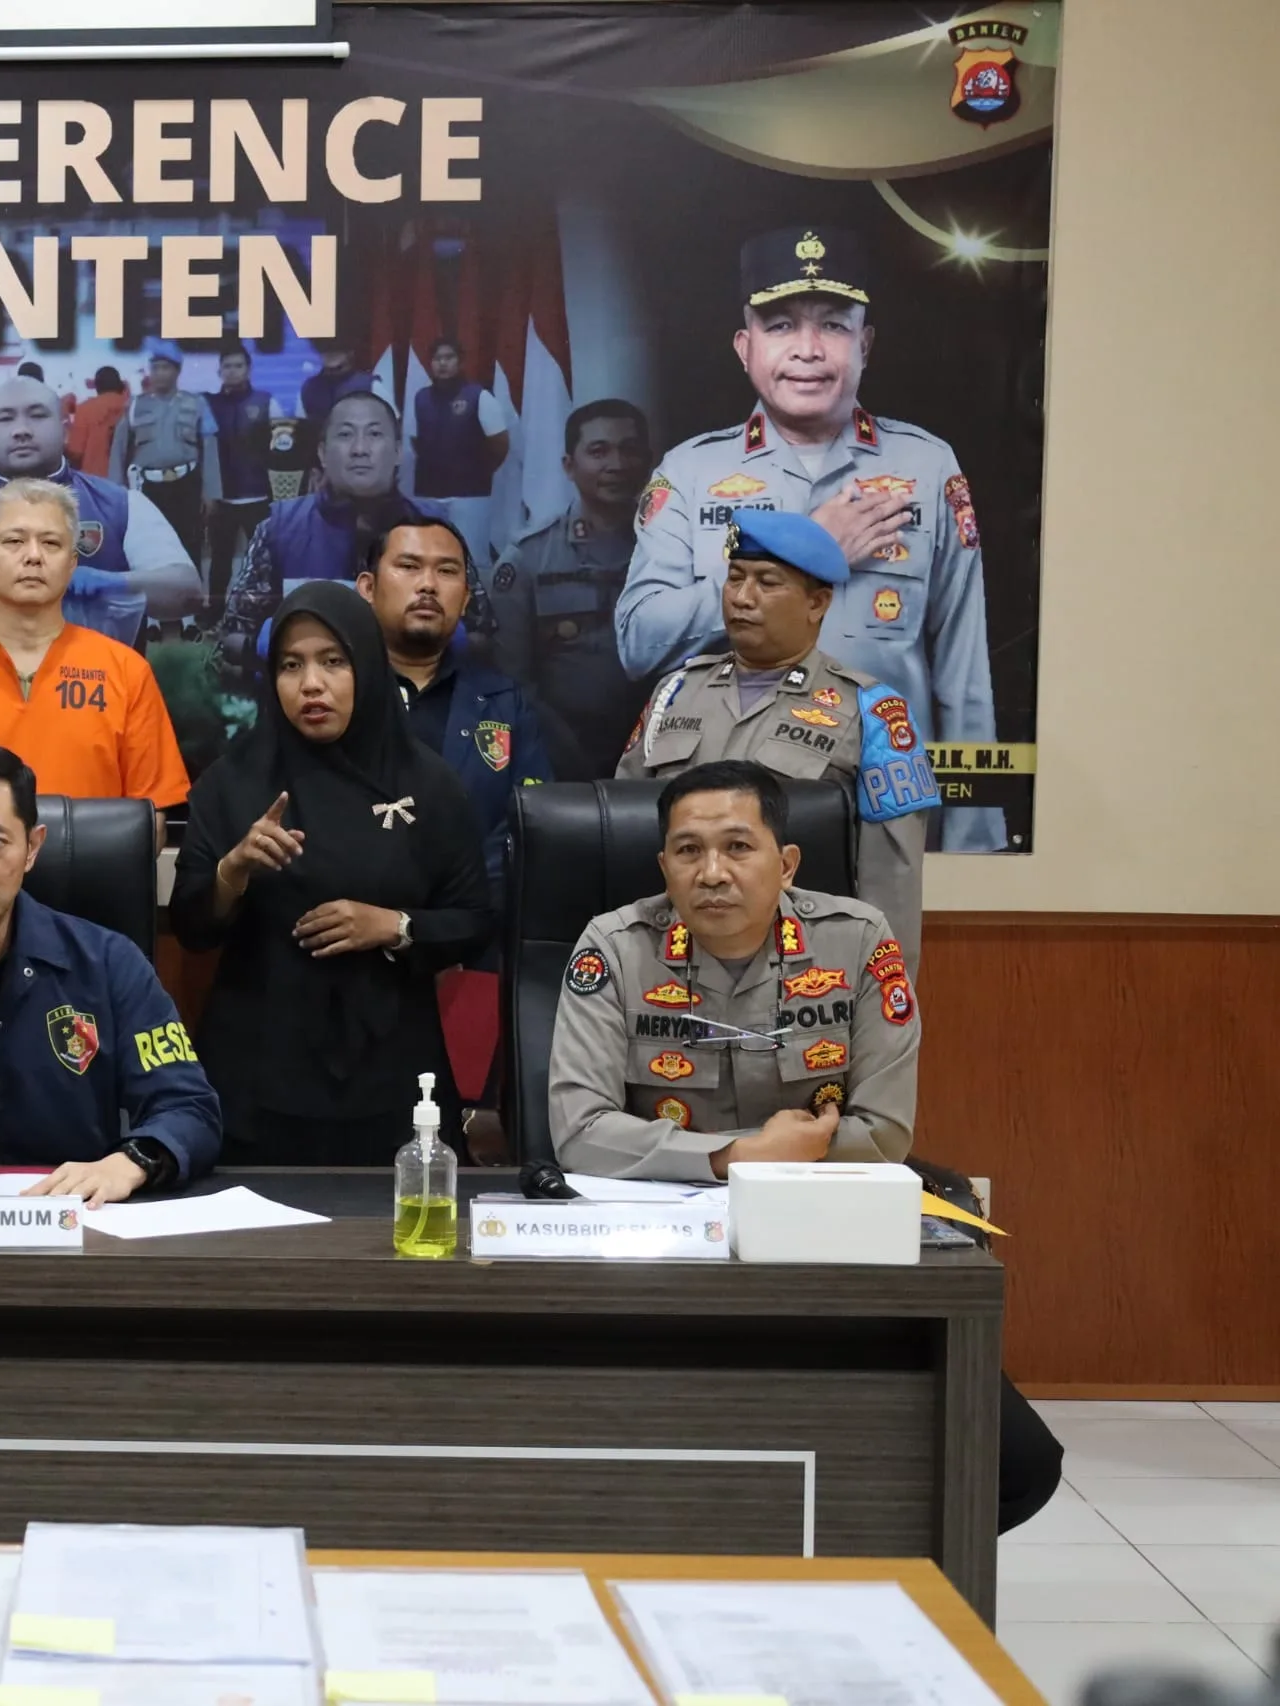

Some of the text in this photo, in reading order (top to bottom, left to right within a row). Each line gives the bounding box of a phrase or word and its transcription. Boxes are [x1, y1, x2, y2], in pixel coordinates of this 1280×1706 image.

[55, 680, 108, 712] 104
[775, 723, 836, 752] POLRI
[778, 1000, 854, 1028] POLRI
[516, 1222, 612, 1237] KASUBBID
